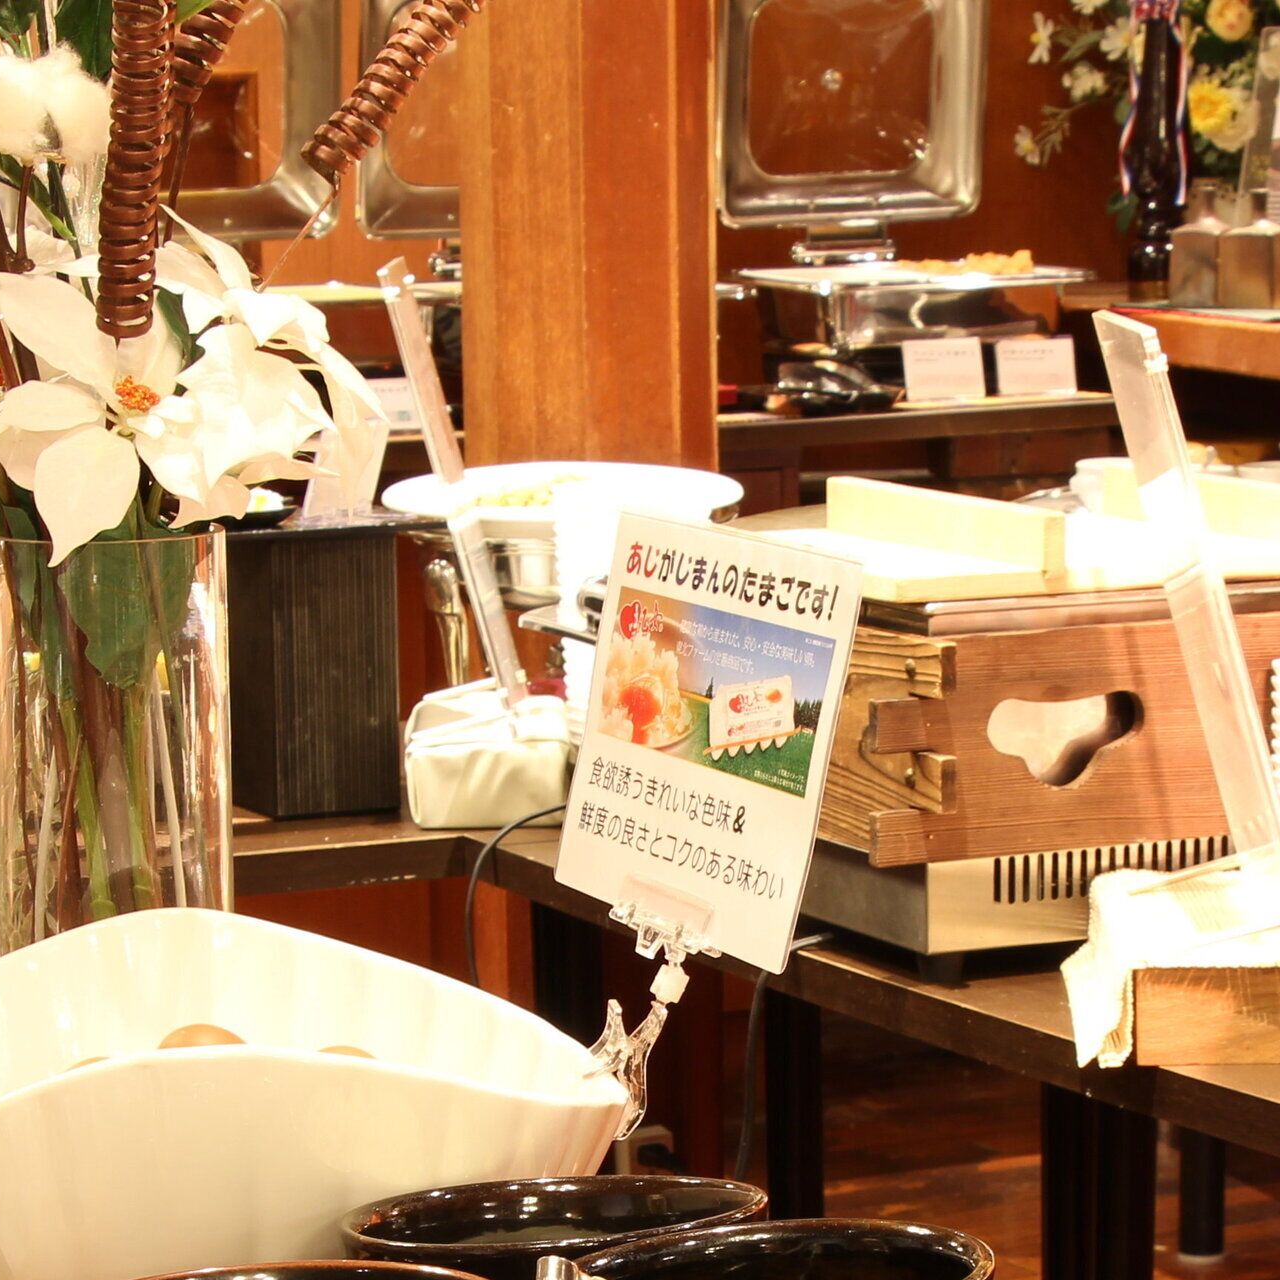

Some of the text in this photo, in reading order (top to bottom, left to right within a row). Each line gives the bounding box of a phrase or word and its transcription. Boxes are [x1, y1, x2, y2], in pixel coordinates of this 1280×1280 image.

[626, 541, 840, 621] あじがじまんのたまごです!
[578, 800, 784, 899] 鮮度の良さとコクのある味わい
